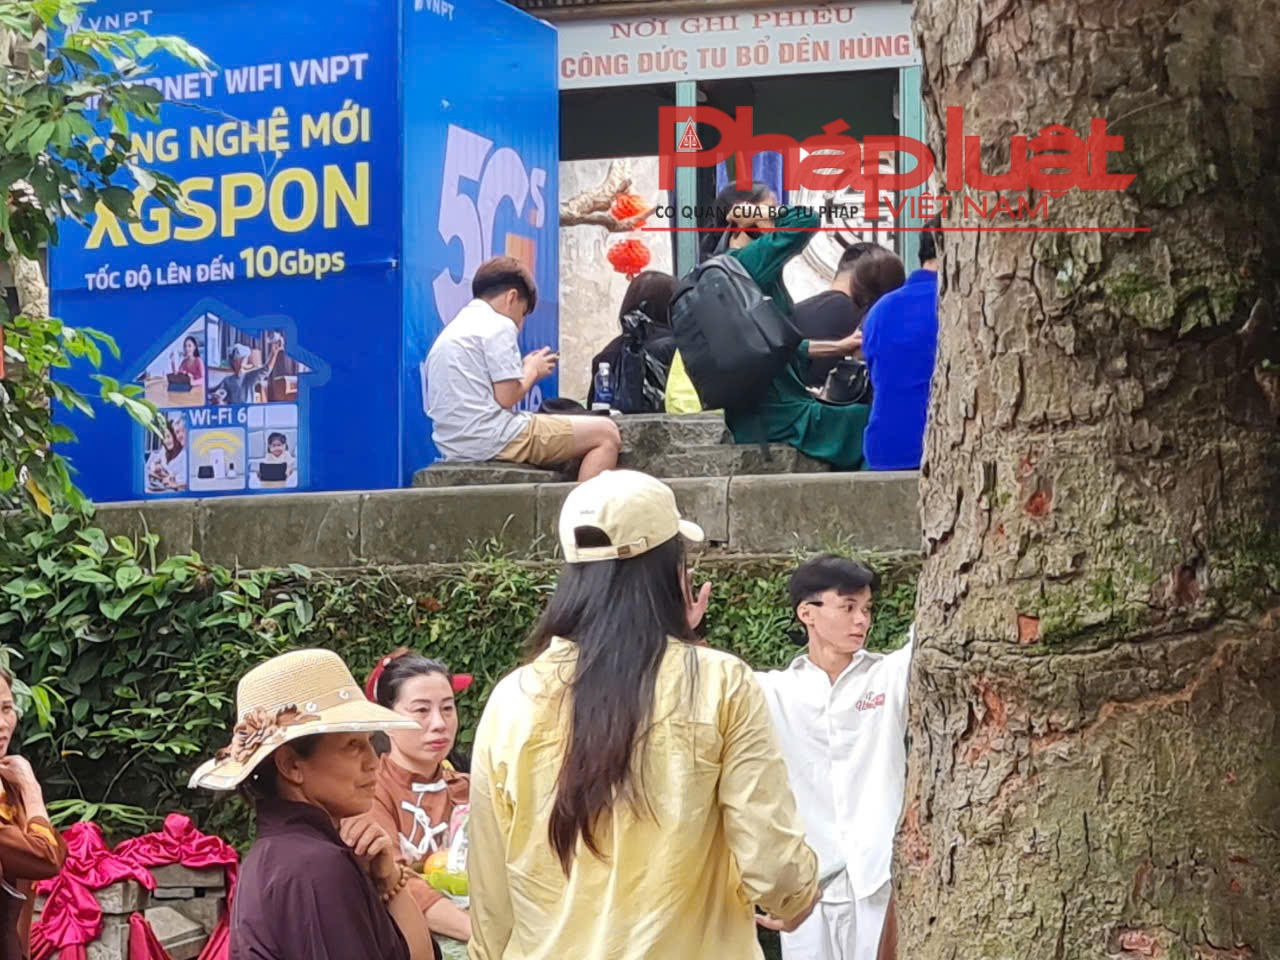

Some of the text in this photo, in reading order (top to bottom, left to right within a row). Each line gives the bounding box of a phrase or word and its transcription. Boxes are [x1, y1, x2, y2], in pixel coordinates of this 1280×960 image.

[88, 10, 153, 31] VNPT
[609, 17, 669, 40] NƠI
[680, 15, 740, 34] GHI
[224, 63, 282, 94] WIFI
[289, 53, 369, 88] VNPT
[561, 52, 629, 79] CÔNG
[697, 47, 727, 69] TU
[839, 33, 911, 60] HÙNG
[190, 106, 290, 159] NGHỆ
[301, 98, 370, 149] MỚI
[85, 245, 345, 292] TỐC ĐỘ LÊN ĐẾN 10Gbps
[237, 406, 247, 424] 6
